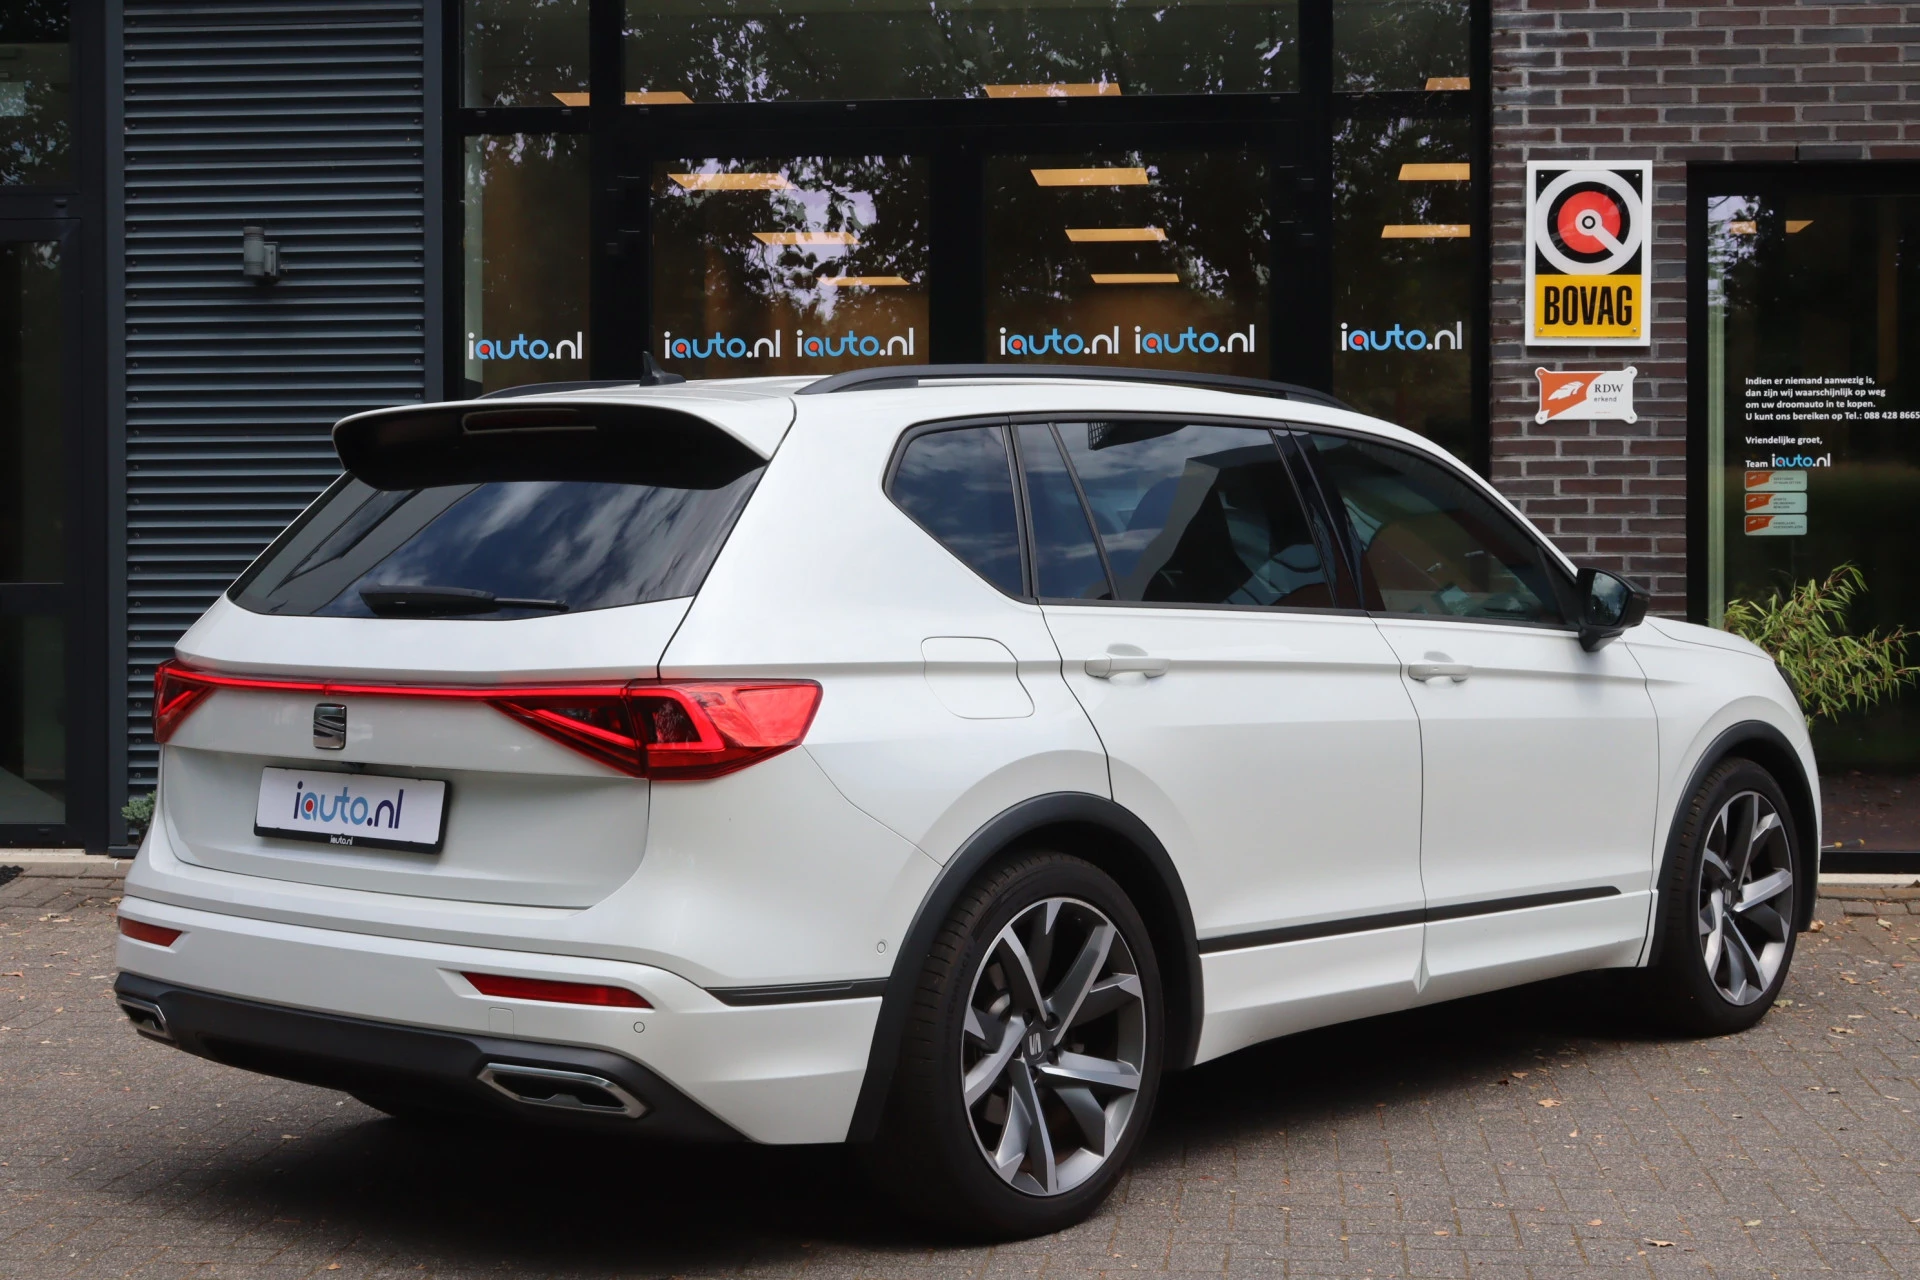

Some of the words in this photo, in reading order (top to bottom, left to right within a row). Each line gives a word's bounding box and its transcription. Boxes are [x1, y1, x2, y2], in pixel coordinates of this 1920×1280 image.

[1543, 285, 1632, 326] BOVAG
[468, 331, 583, 360] iauto.nl
[664, 330, 781, 359] iauto.nl
[797, 328, 914, 358] iauto.nl
[1000, 326, 1119, 355] iauto.nl
[1134, 324, 1255, 354] iauto.nl
[1341, 321, 1463, 351] iauto.nl
[1594, 384, 1623, 393] RDW
[1745, 377, 1772, 385] Indien
[1785, 376, 1822, 385] niemand
[1824, 376, 1864, 386] aanwezig
[1866, 376, 1875, 385] is,
[1745, 388, 1761, 397] dan
[1763, 388, 1778, 399] zijn
[1780, 388, 1793, 398] wij
[1795, 387, 1853, 398] waarschijnlijk
[1855, 389, 1866, 398] op
[1868, 389, 1885, 398] weg
[1745, 412, 1752, 420] U
[1754, 412, 1773, 421] kunt
[1775, 413, 1790, 421] ons
[1792, 411, 1829, 420] bereiken
[1831, 413, 1842, 422] op
[1844, 411, 1862, 420] Tel.:
[1864, 411, 1880, 420] 088
[1881, 411, 1897, 420] 428
[1899, 411, 1920, 420] 8665
[1776, 400, 1824, 409] droomauto
[1826, 400, 1834, 408] in
[1836, 400, 1845, 408] te
[1847, 399, 1876, 410] kopen.
[1745, 436, 1795, 446] Vriendelijke
[1797, 437, 1823, 446] groet,
[1745, 459, 1768, 468] Team
[1771, 453, 1831, 468] iauto.nl
[294, 781, 404, 829] iauto.nl
